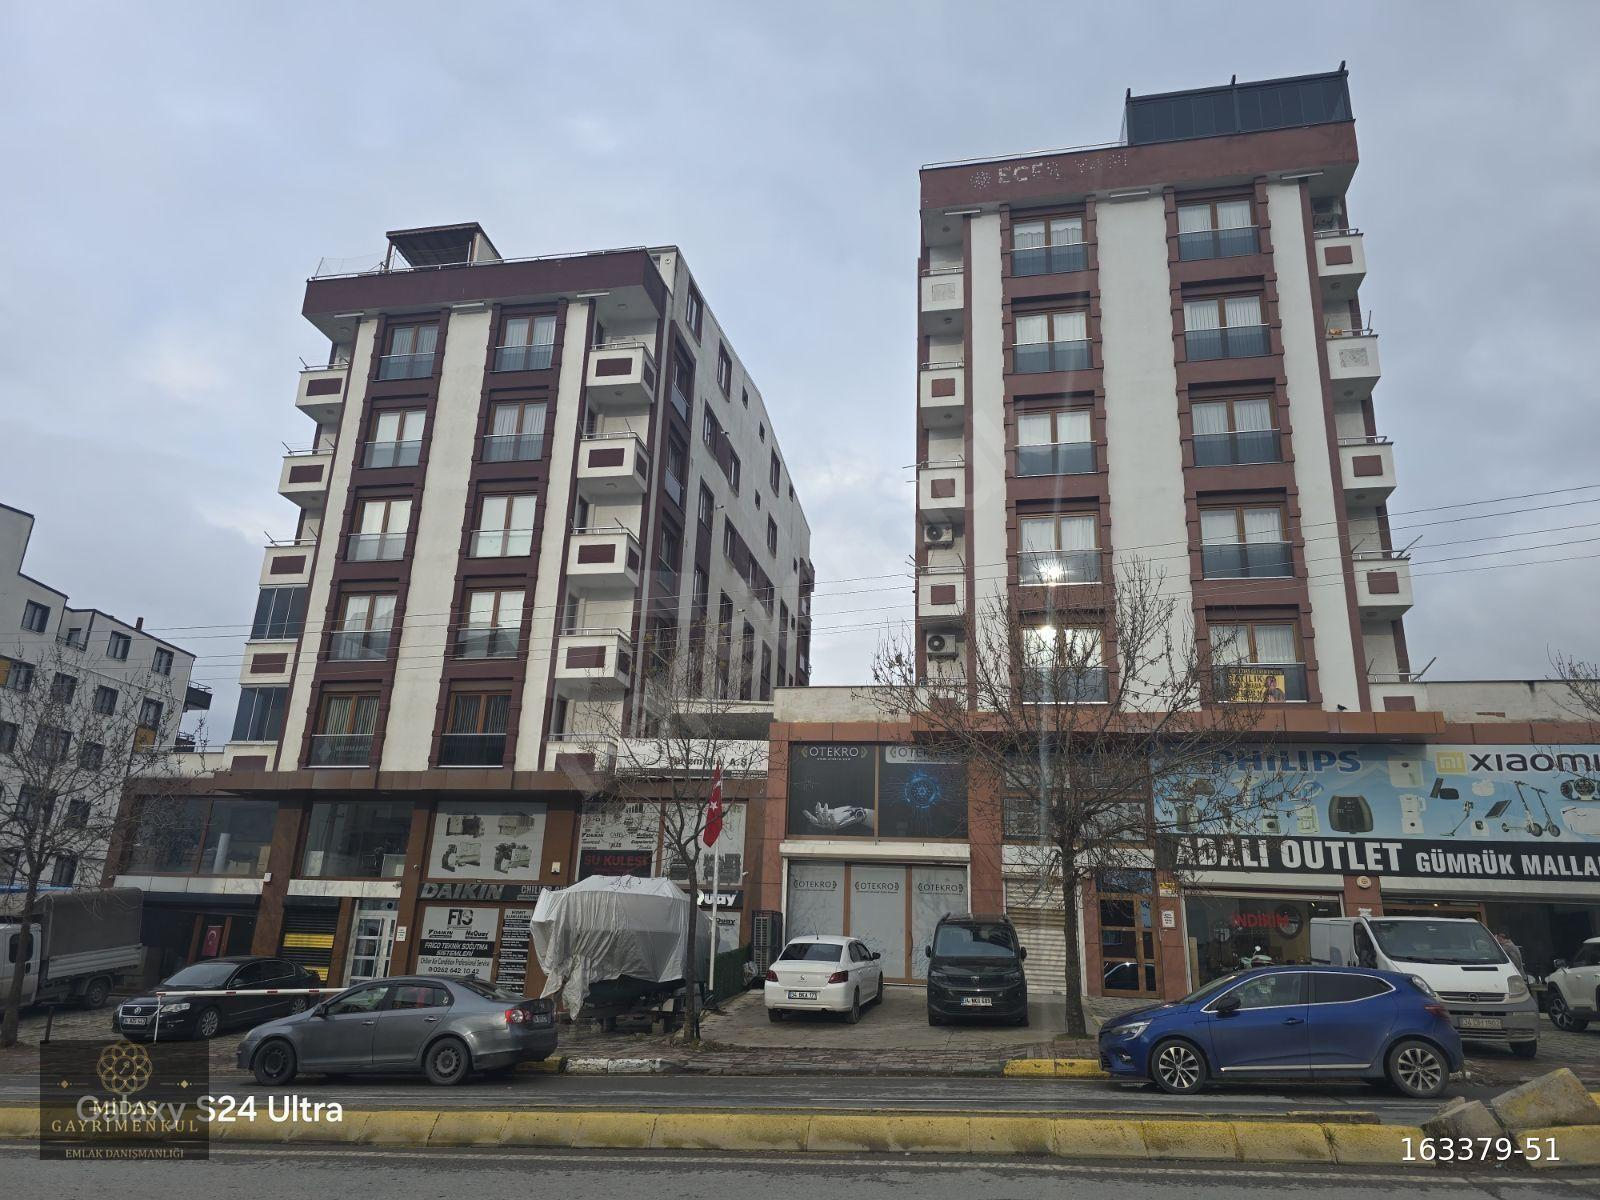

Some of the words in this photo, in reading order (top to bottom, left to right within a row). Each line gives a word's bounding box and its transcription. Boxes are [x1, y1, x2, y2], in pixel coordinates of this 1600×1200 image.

[809, 746, 859, 757] OTEKRO
[1176, 836, 1270, 868] ADALI
[1280, 839, 1403, 873] OUTLET
[1415, 848, 1516, 875] GÜMRÜK
[1520, 853, 1600, 878] MALLA
[420, 883, 505, 900] DAIKIN
